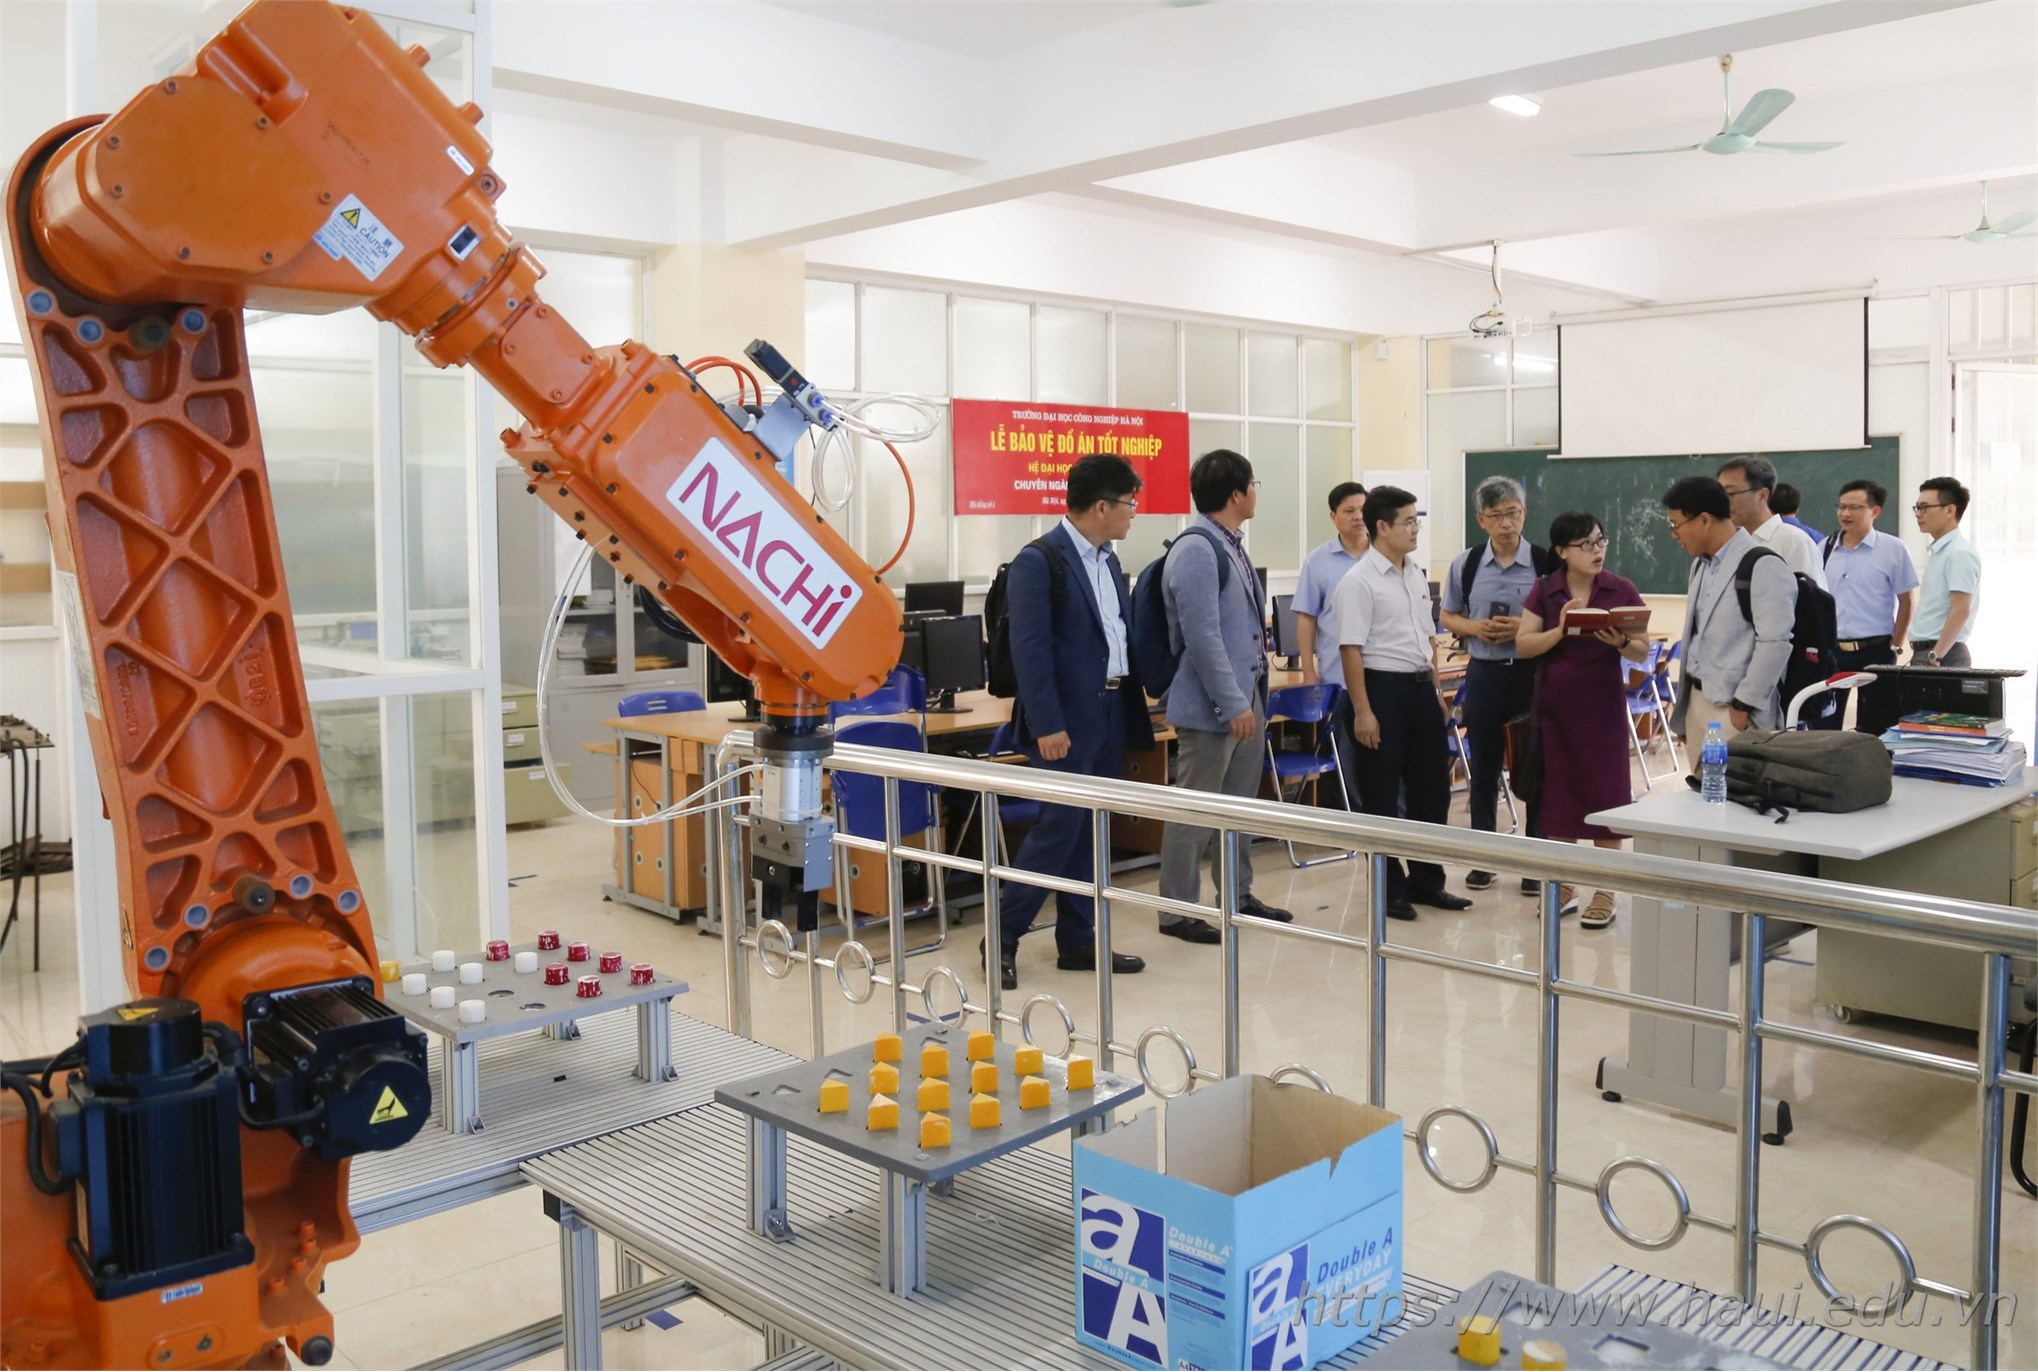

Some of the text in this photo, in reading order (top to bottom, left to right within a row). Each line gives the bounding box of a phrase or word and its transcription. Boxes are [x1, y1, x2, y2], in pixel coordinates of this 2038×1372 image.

[360, 227, 390, 258] CAUTION
[1012, 409, 1042, 420] TRƯỜNG
[1058, 413, 1073, 423] HỌC
[1121, 415, 1131, 425] HÀ
[990, 423, 1163, 460] LỄ BẢO VỆ ĐỒ ÁN TỐT NGHIỆP
[1028, 460, 1040, 475] HỆ
[1014, 478, 1047, 491] CHUYÊN
[1169, 1226, 1216, 1253] Double
[1220, 1244, 1231, 1258] A
[1317, 1226, 1393, 1285] Double A
[1093, 1258, 1136, 1284] Double
[1140, 1277, 1150, 1290] A
